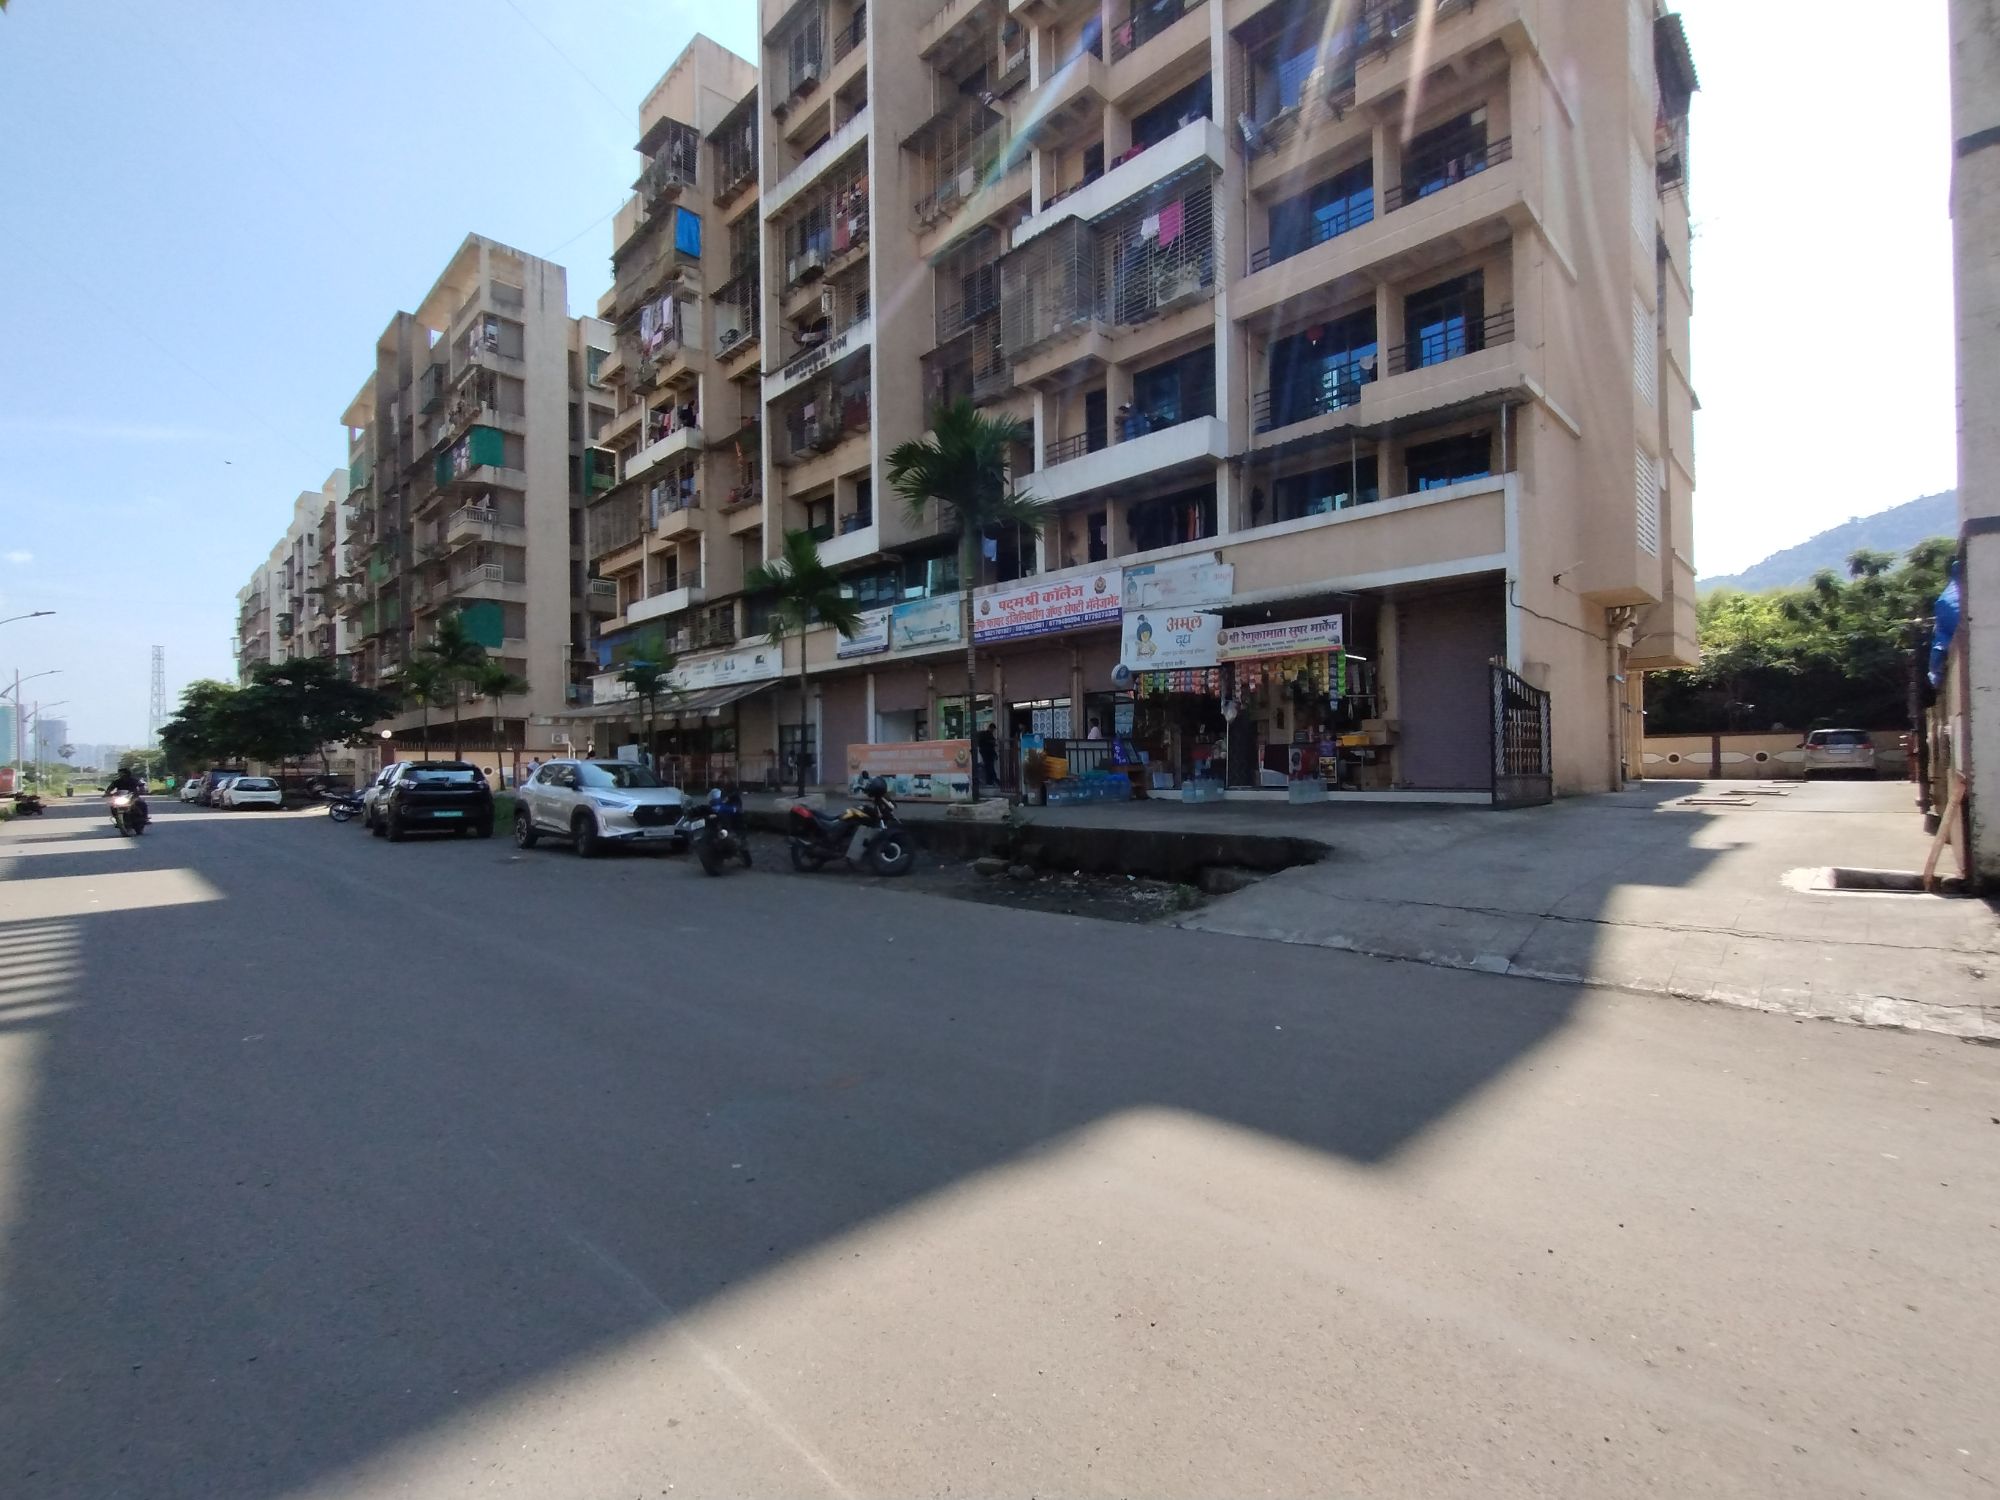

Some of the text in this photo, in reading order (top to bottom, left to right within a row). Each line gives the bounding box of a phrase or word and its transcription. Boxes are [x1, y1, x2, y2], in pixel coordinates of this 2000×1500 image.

[1042, 584, 1084, 602] कॉलेज
[1166, 615, 1203, 632] अमूल
[1229, 630, 1240, 643] श्री
[1288, 623, 1308, 638] सुपर
[1310, 618, 1338, 632] मार्केट
[1175, 633, 1192, 647] दूध
